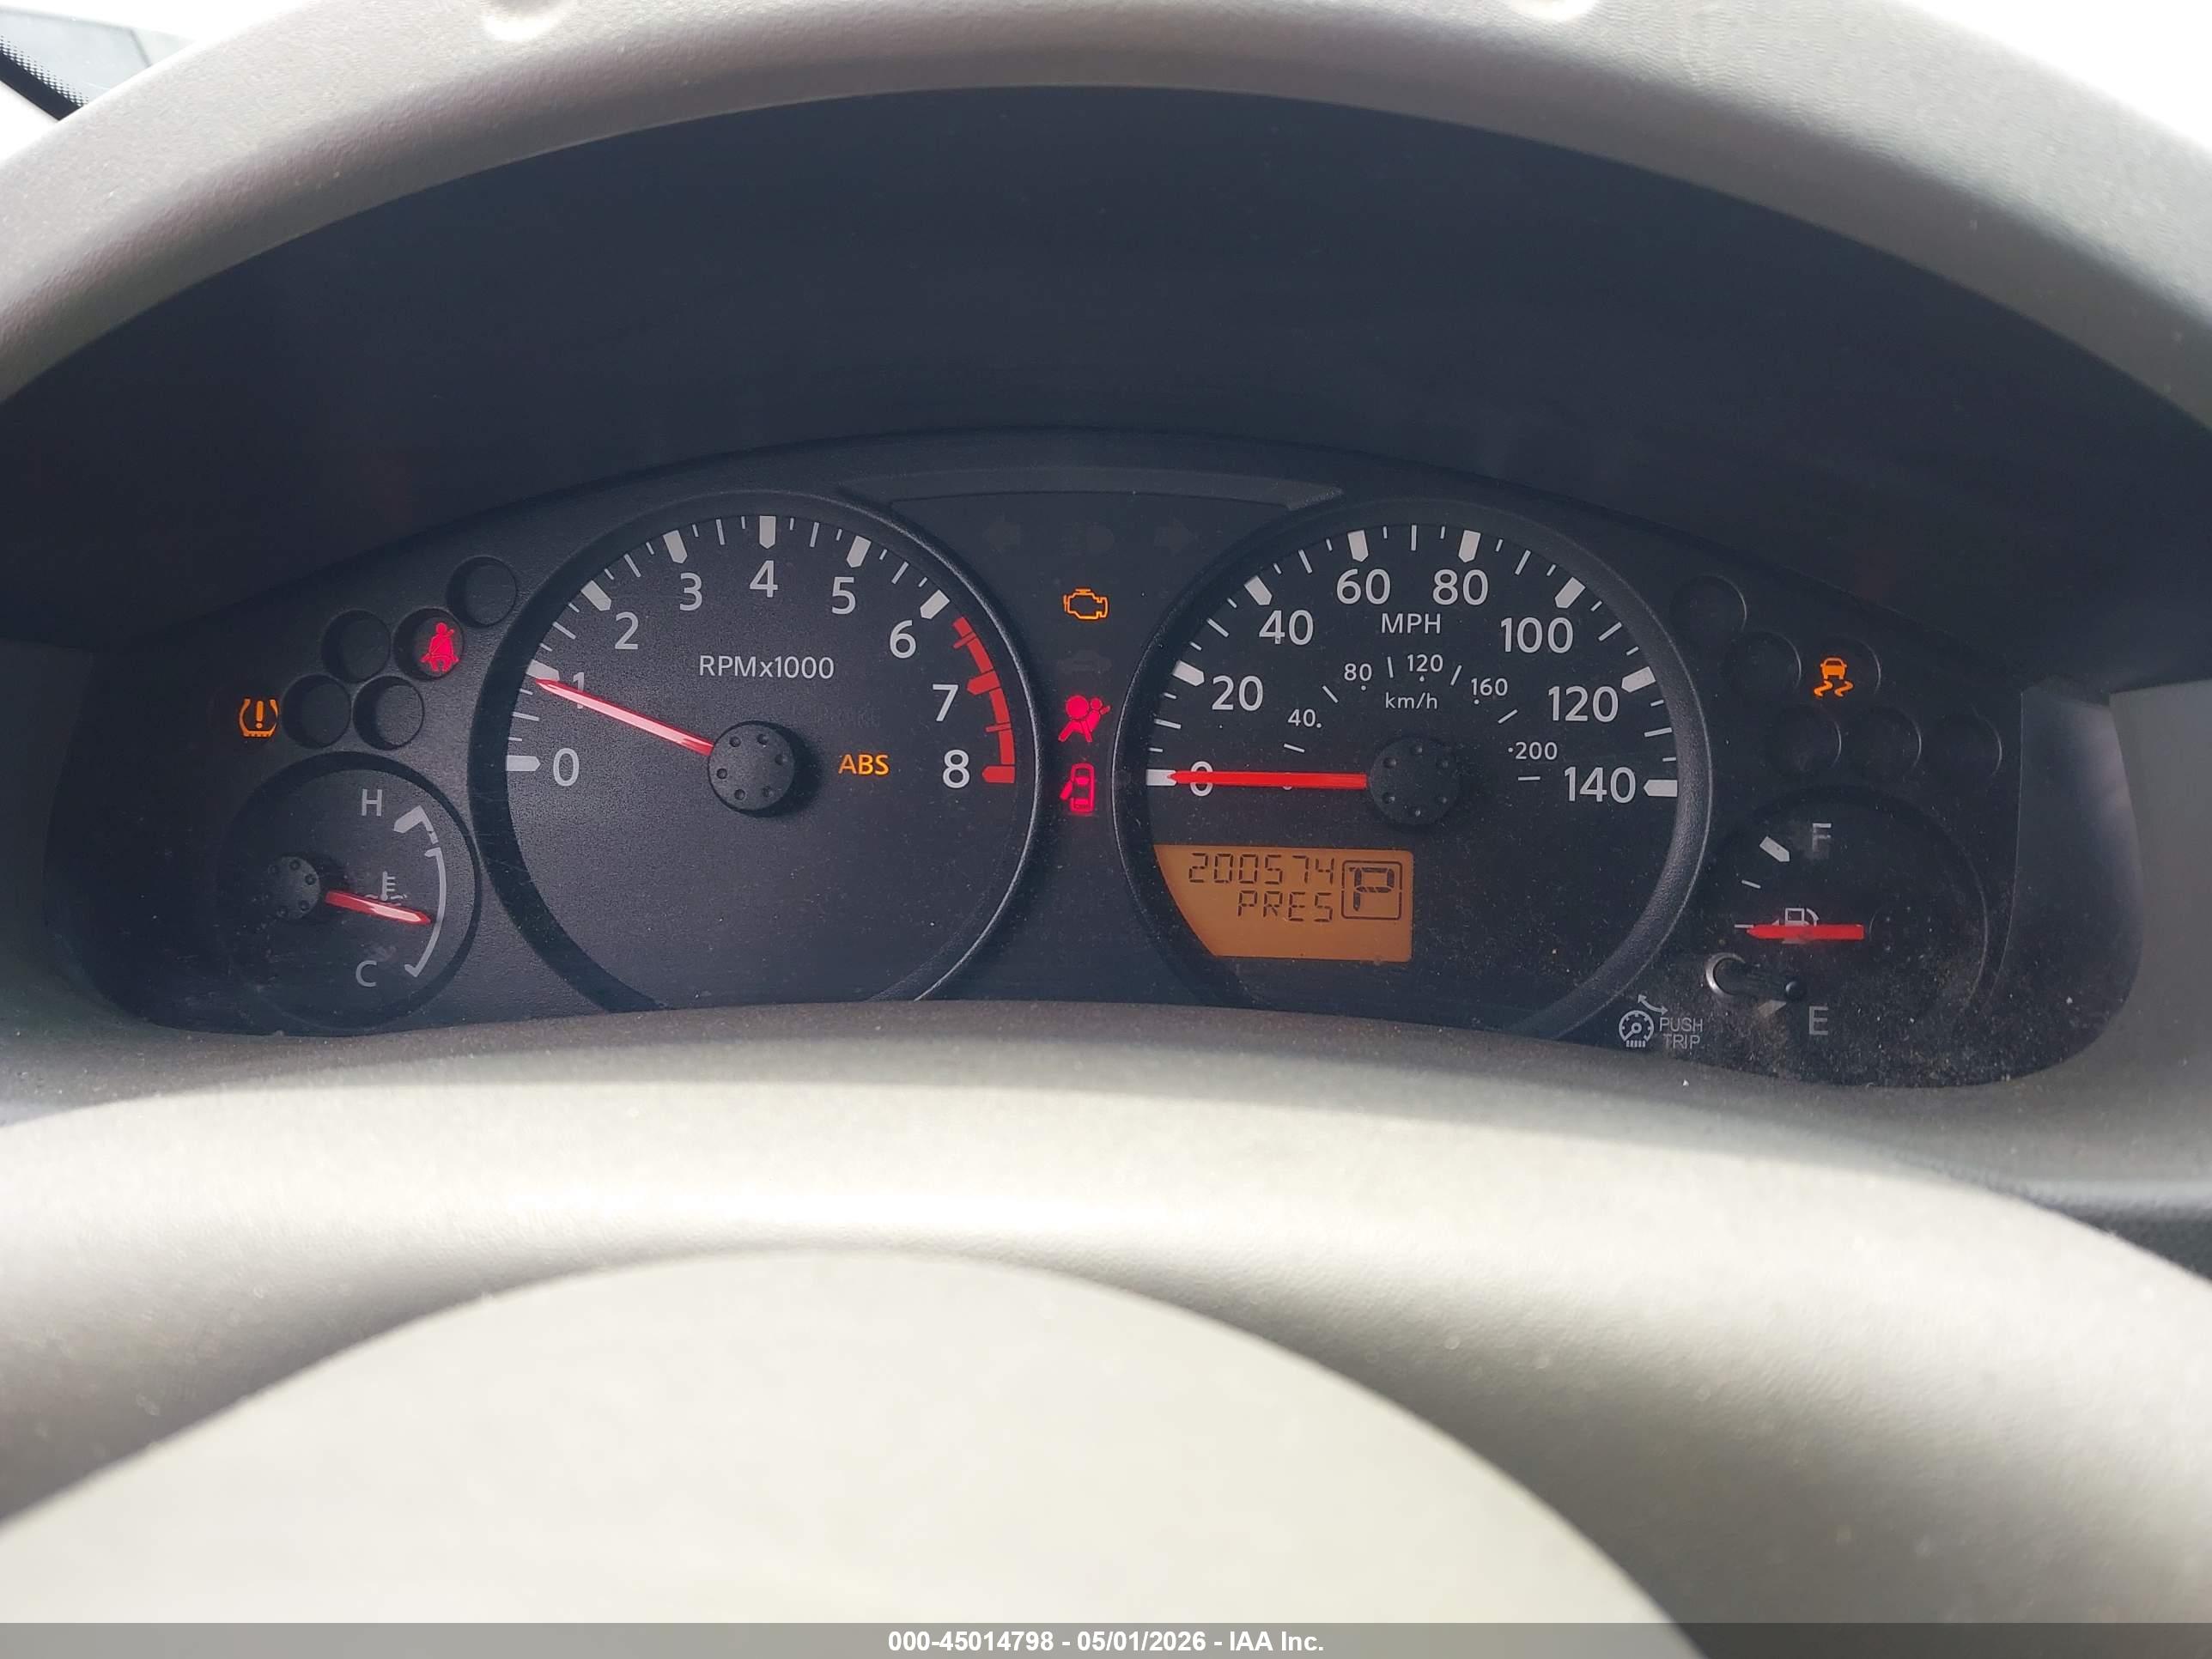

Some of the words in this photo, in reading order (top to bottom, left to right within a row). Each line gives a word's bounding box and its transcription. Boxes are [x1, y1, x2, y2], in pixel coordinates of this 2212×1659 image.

[679, 572, 702, 611] 3
[749, 560, 779, 598] 4
[831, 576, 856, 615] 5
[1336, 568, 1391, 605] 60
[1432, 568, 1488, 605] 80
[614, 611, 639, 650] 2
[890, 619, 916, 659] 6
[1259, 610, 1314, 646] 40
[1381, 612, 1443, 635] MPH
[1500, 617, 1573, 653] 100
[699, 654, 835, 679] RPMx1000
[1344, 663, 1372, 682] 80
[1407, 653, 1443, 672] 120
[933, 684, 959, 722] 7
[1212, 675, 1263, 711] 20
[1385, 691, 1437, 710] km/h
[1471, 678, 1508, 696] 160
[1548, 685, 1619, 723] 120
[1287, 708, 1316, 727] 40
[552, 747, 580, 787] 0
[838, 754, 890, 776] ABS
[1515, 741, 1559, 760] 200
[942, 749, 970, 788] 8
[1564, 766, 1636, 804] 140
[361, 788, 383, 817] H
[1188, 852, 1335, 885] 200574
[1236, 889, 1334, 923] PRES
[1350, 867, 1395, 911] P
[356, 959, 378, 988] C
[1658, 1016, 1703, 1034] PUSH
[1808, 1006, 1829, 1036] E
[1662, 1033, 1701, 1050] TRIP
